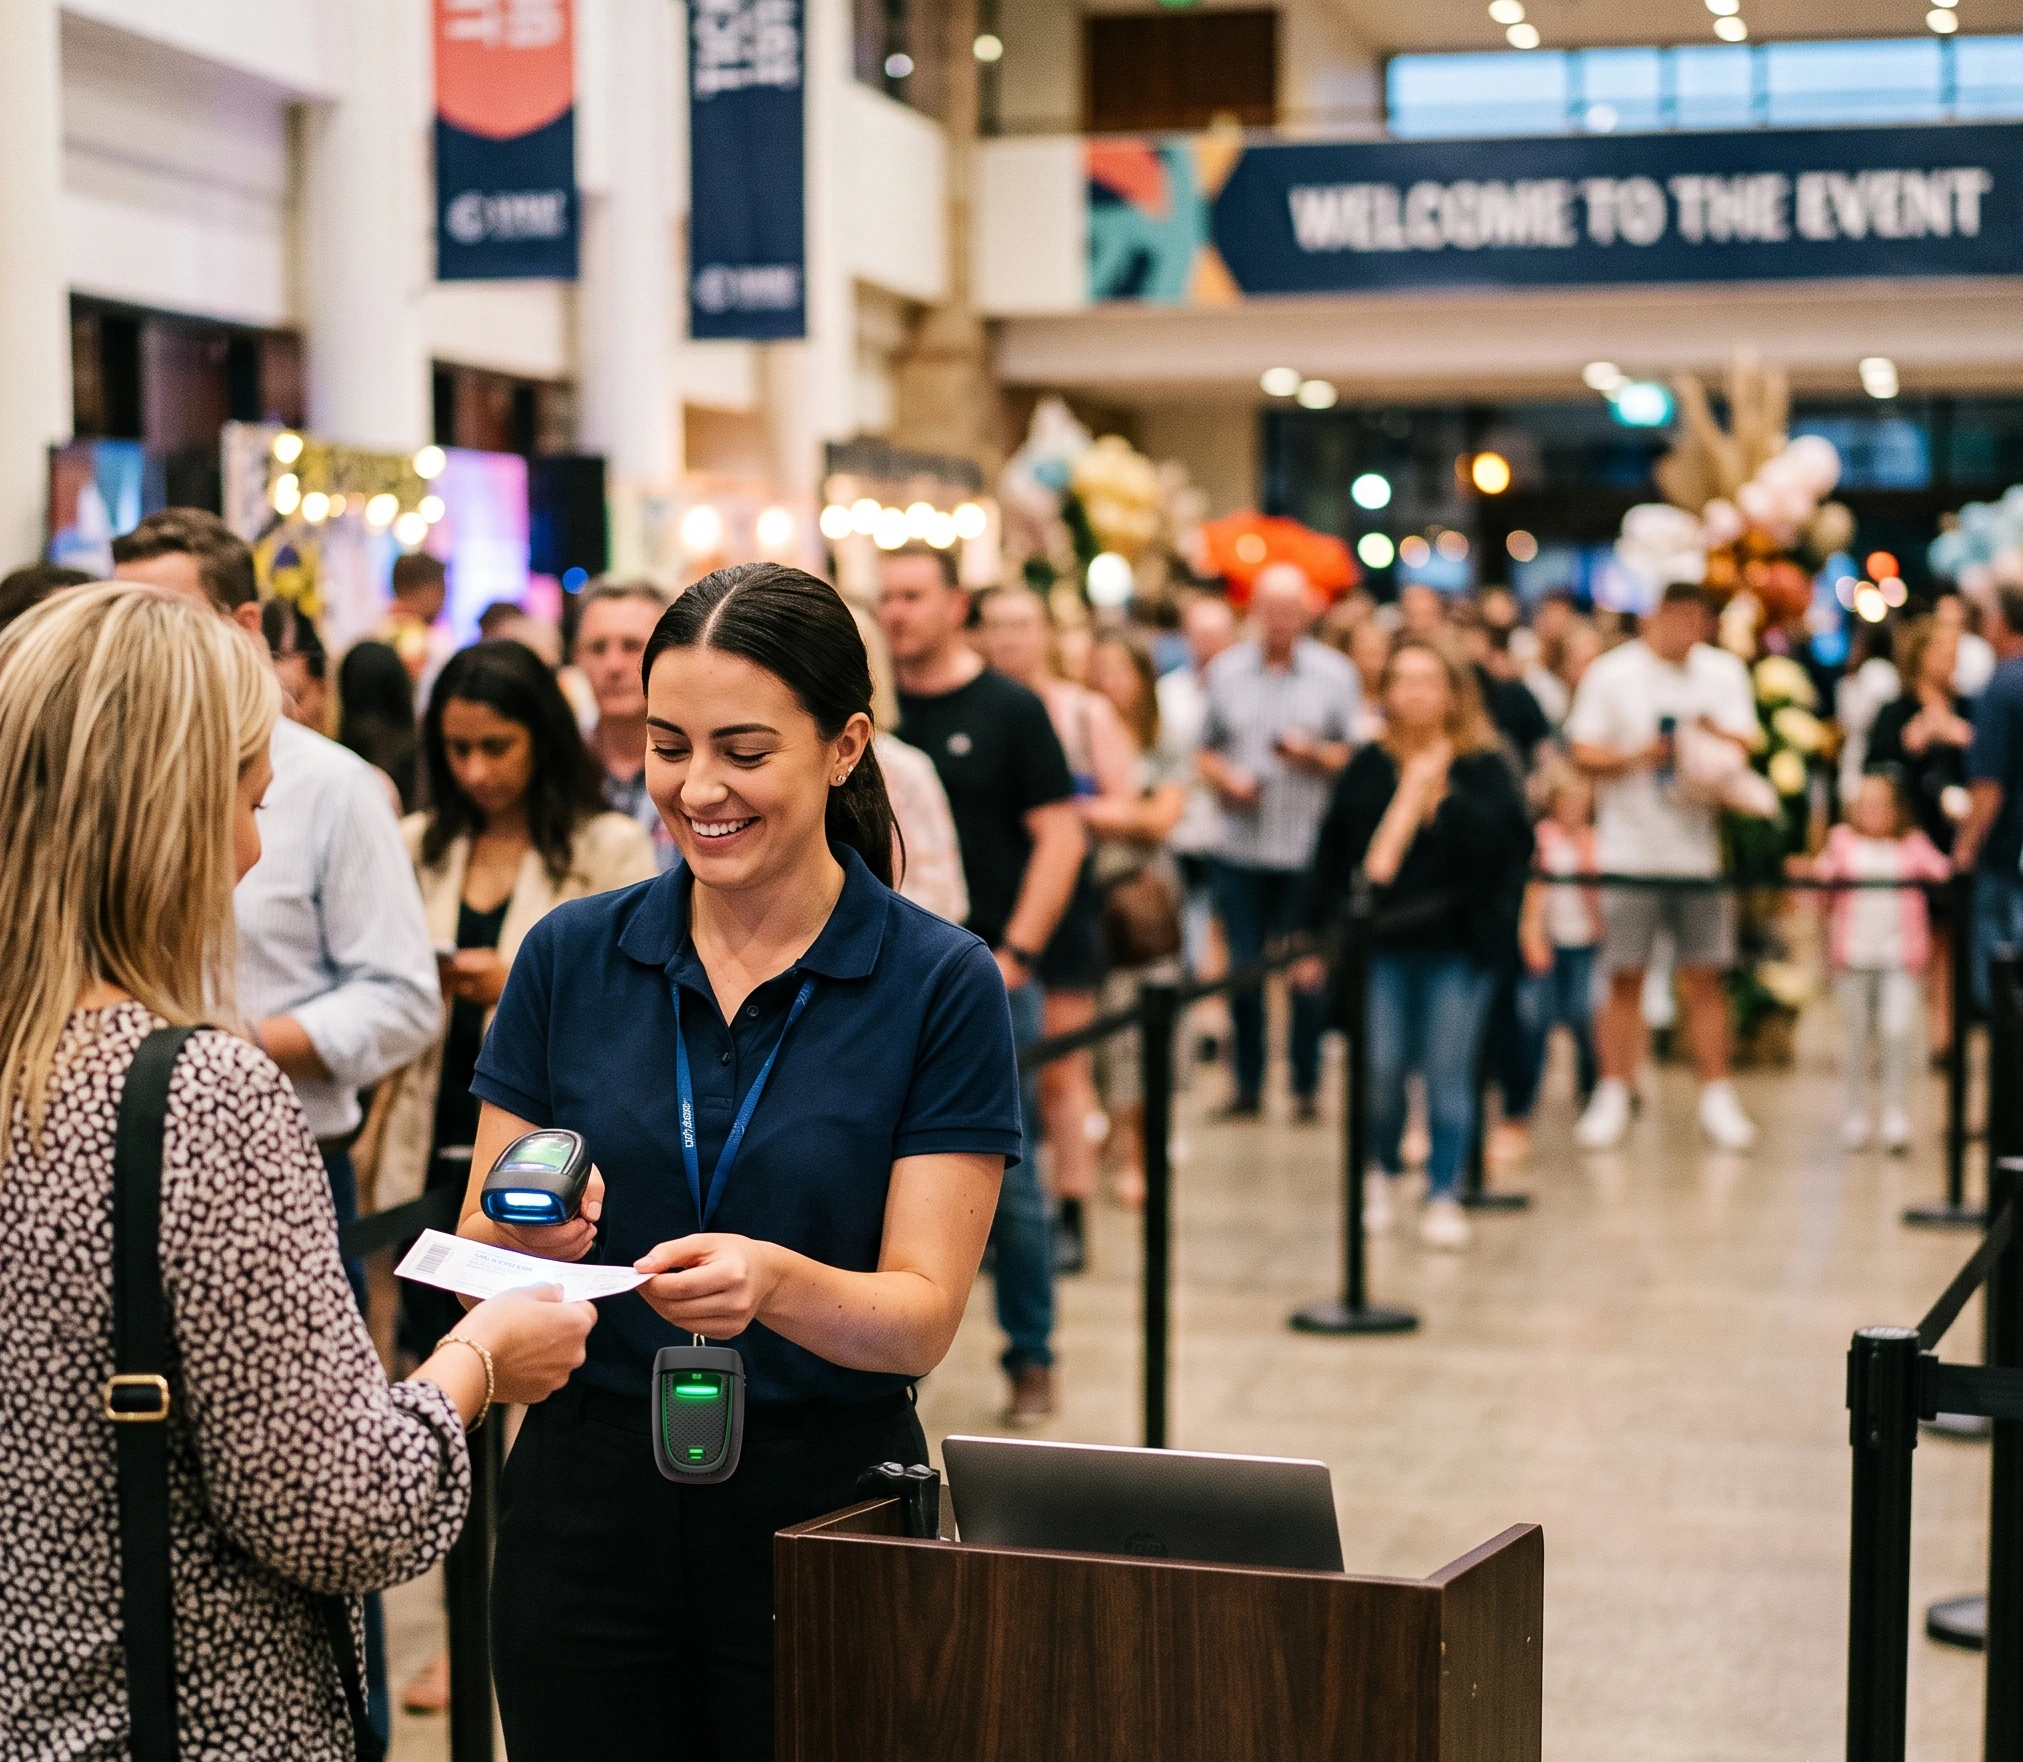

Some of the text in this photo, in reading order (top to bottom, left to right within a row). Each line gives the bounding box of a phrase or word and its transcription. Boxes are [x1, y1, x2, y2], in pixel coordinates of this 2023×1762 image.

[1289, 167, 1991, 251] WELCOME TO THE EVENT
